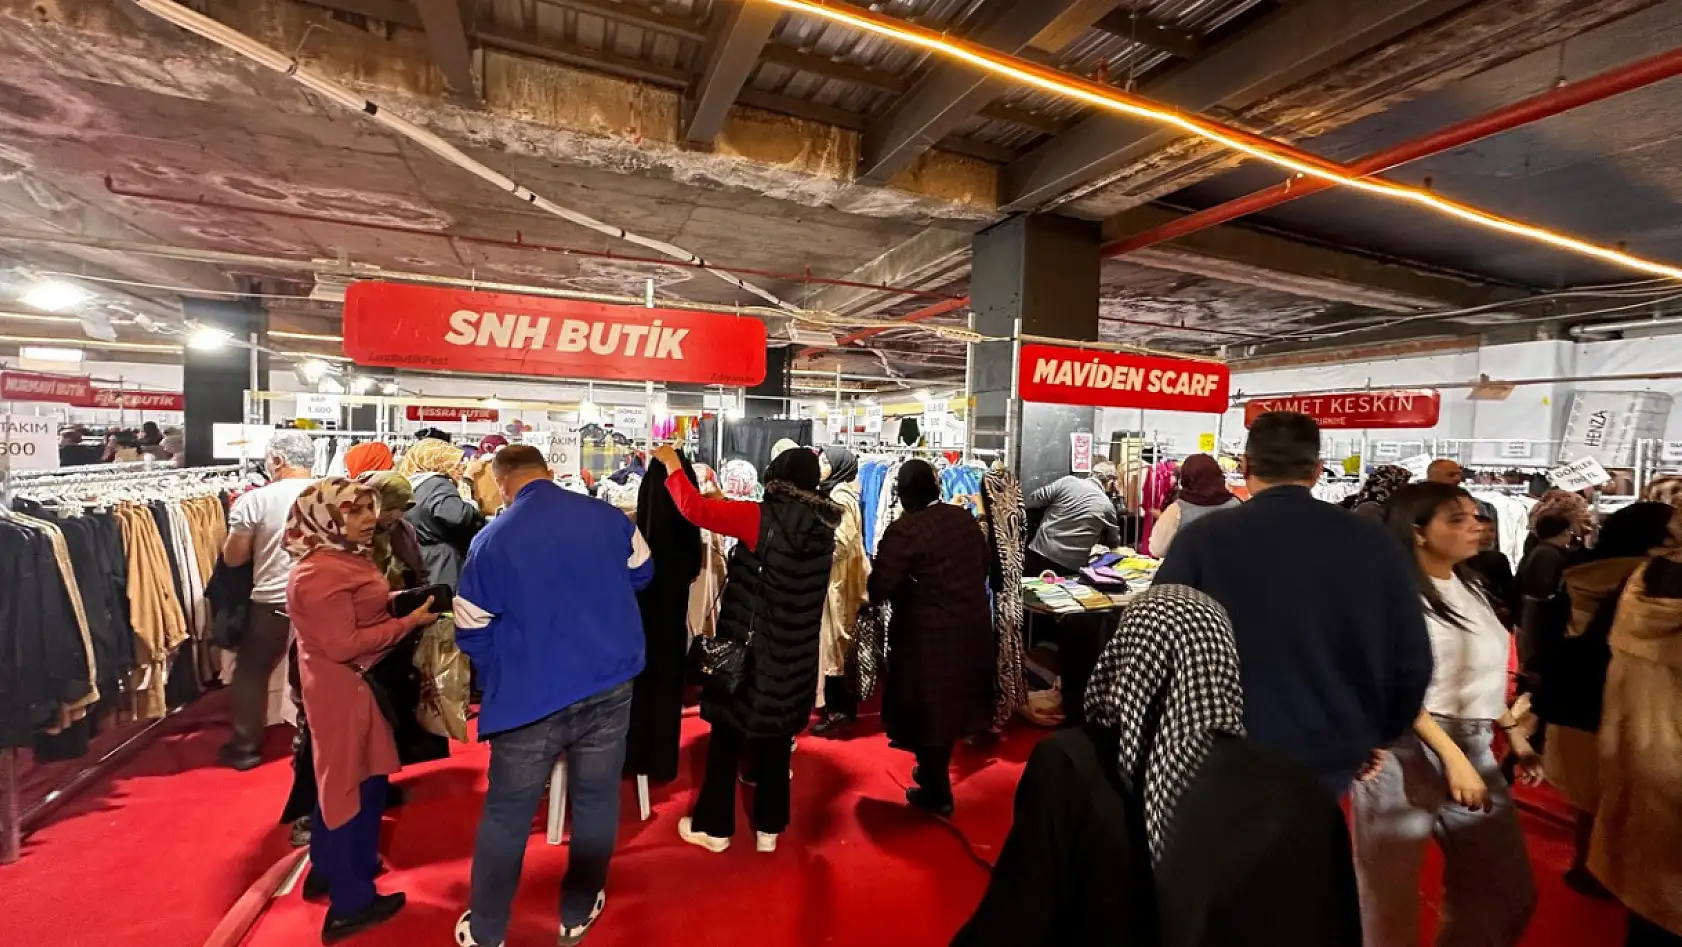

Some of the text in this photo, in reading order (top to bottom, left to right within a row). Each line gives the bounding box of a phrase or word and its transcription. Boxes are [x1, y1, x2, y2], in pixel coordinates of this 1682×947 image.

[444, 309, 690, 360] SNH BUTİK
[1033, 358, 1220, 397] MAVİDEN SCARF
[1263, 399, 1324, 415] SAMET
[0, 422, 48, 434] TAKIM
[1583, 409, 1608, 447] HENZA
